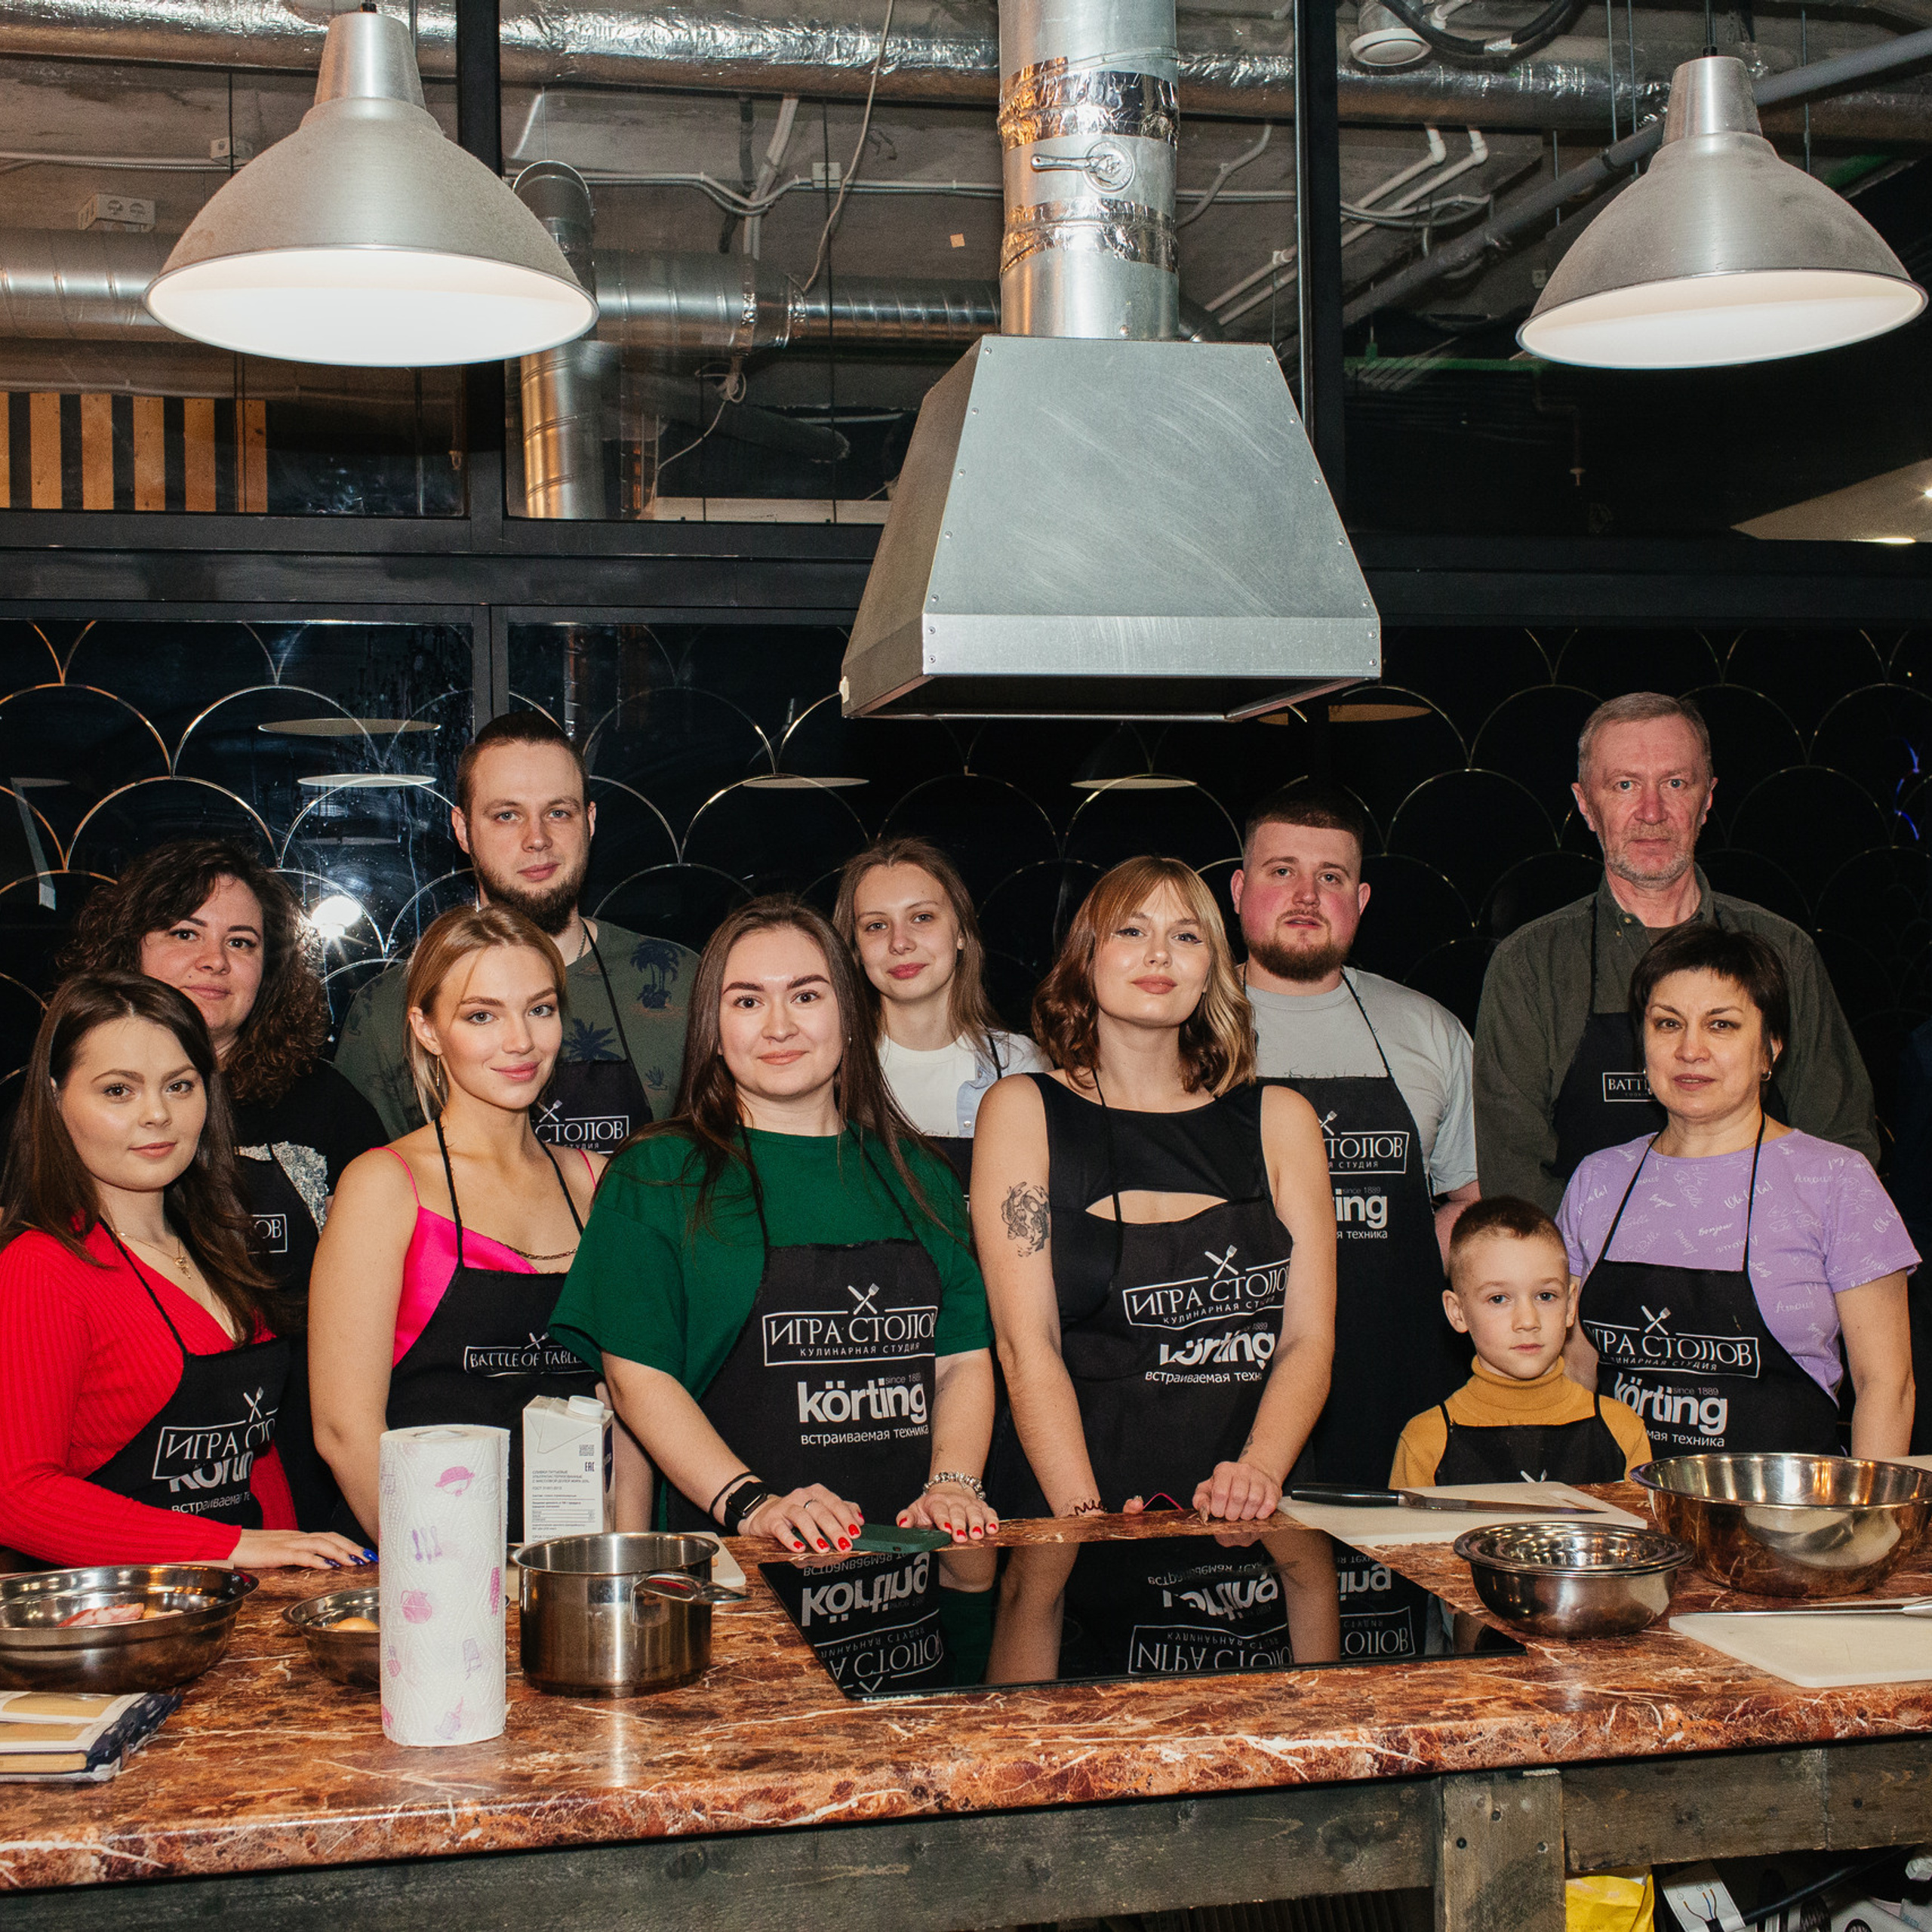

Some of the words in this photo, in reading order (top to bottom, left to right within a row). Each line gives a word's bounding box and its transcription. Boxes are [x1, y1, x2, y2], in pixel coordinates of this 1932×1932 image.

[1608, 1078, 1648, 1091] BATT
[535, 1121, 624, 1143] СТОЛОВ
[1324, 1137, 1403, 1159] ТОЛОВ
[1339, 1161, 1379, 1169] СТУДИЯ
[1347, 1230, 1388, 1239] техника
[1131, 1286, 1203, 1316] ИГРА
[1209, 1266, 1290, 1302] СТОЛО
[1163, 1302, 1239, 1324] КУЛИНАРНАЯ
[769, 1318, 844, 1346] ИГРА
[800, 1345, 877, 1357] КУЛИНАРНАЯ
[881, 1342, 920, 1354] СТУДИЯ
[1641, 1334, 1752, 1367] СТОЛОВ
[469, 1353, 519, 1367] BATTLE
[521, 1352, 540, 1367] OF
[1672, 1359, 1718, 1371] СТУДИЯ
[1144, 1371, 1231, 1386] встраиваемая
[797, 1377, 928, 1424] körting
[1672, 1386, 1695, 1395] since
[1697, 1386, 1720, 1396] 1889
[801, 1429, 891, 1447] встраиваемая
[893, 1423, 930, 1439] техника
[1672, 1432, 1726, 1448] техника
[165, 1431, 239, 1460] ИГРА
